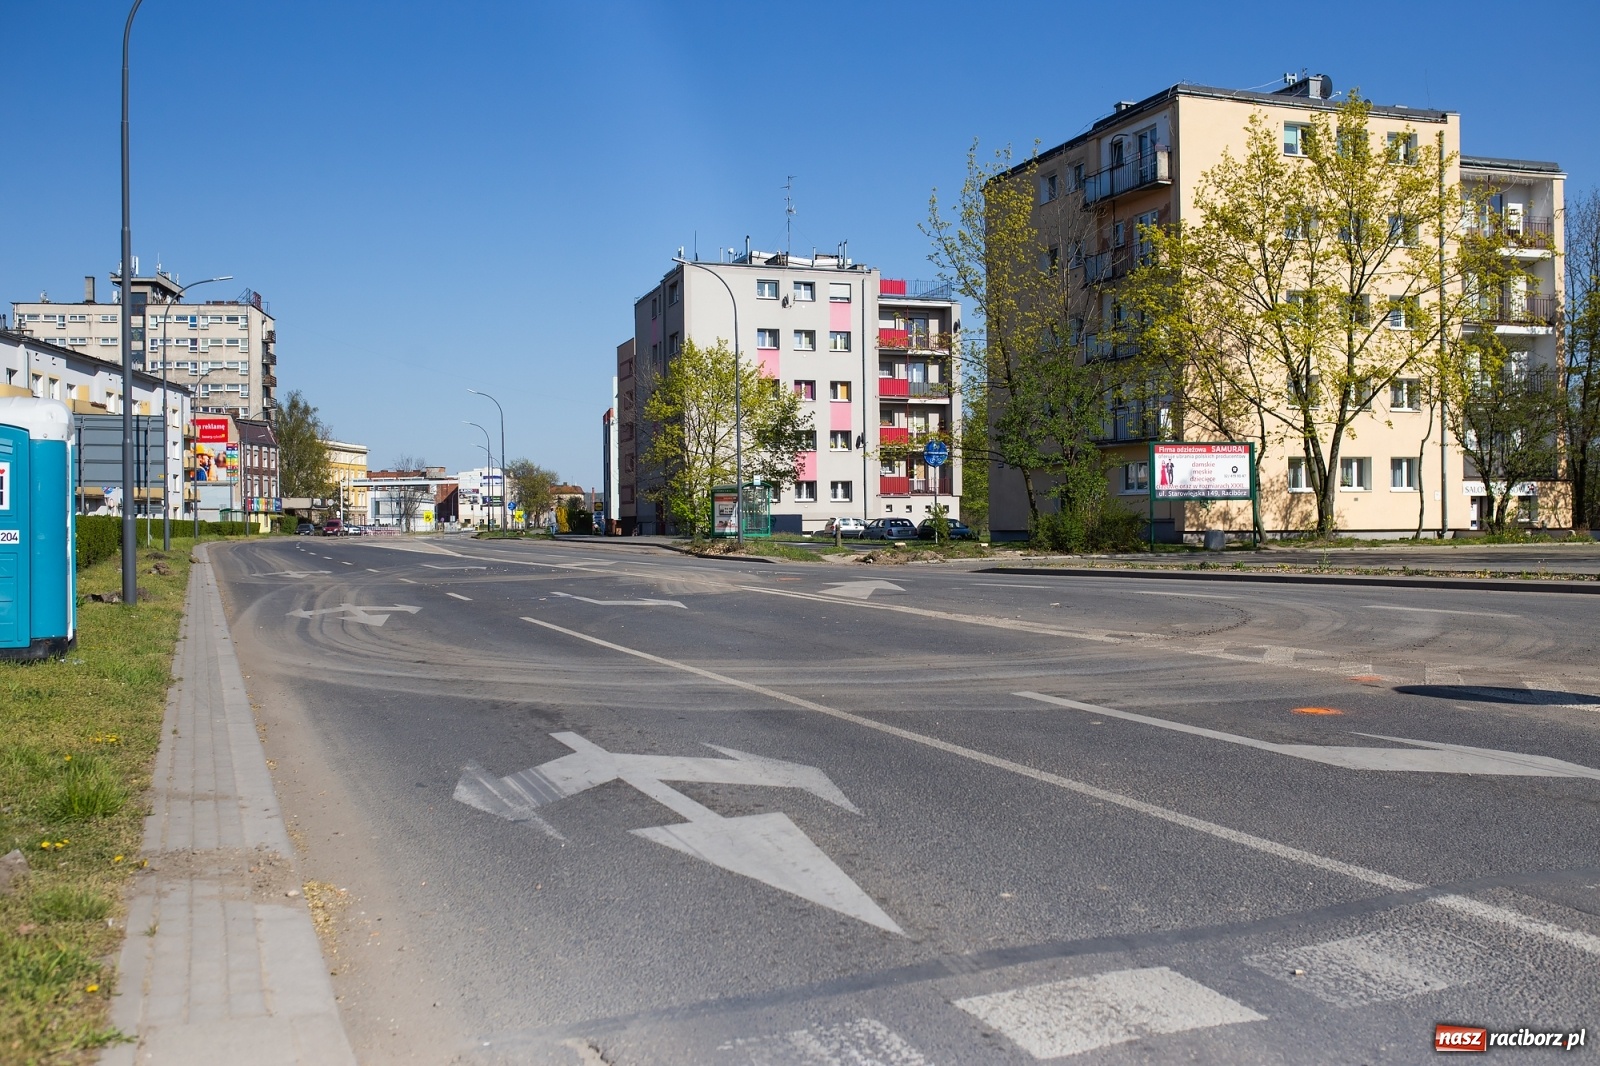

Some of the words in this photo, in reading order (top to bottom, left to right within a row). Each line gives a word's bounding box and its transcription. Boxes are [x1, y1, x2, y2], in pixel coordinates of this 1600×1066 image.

[1176, 445, 1207, 453] odzieżowa
[1211, 445, 1245, 454] SAMURAJ
[1192, 468, 1213, 476] męskie
[1190, 475, 1216, 483] dziecięce
